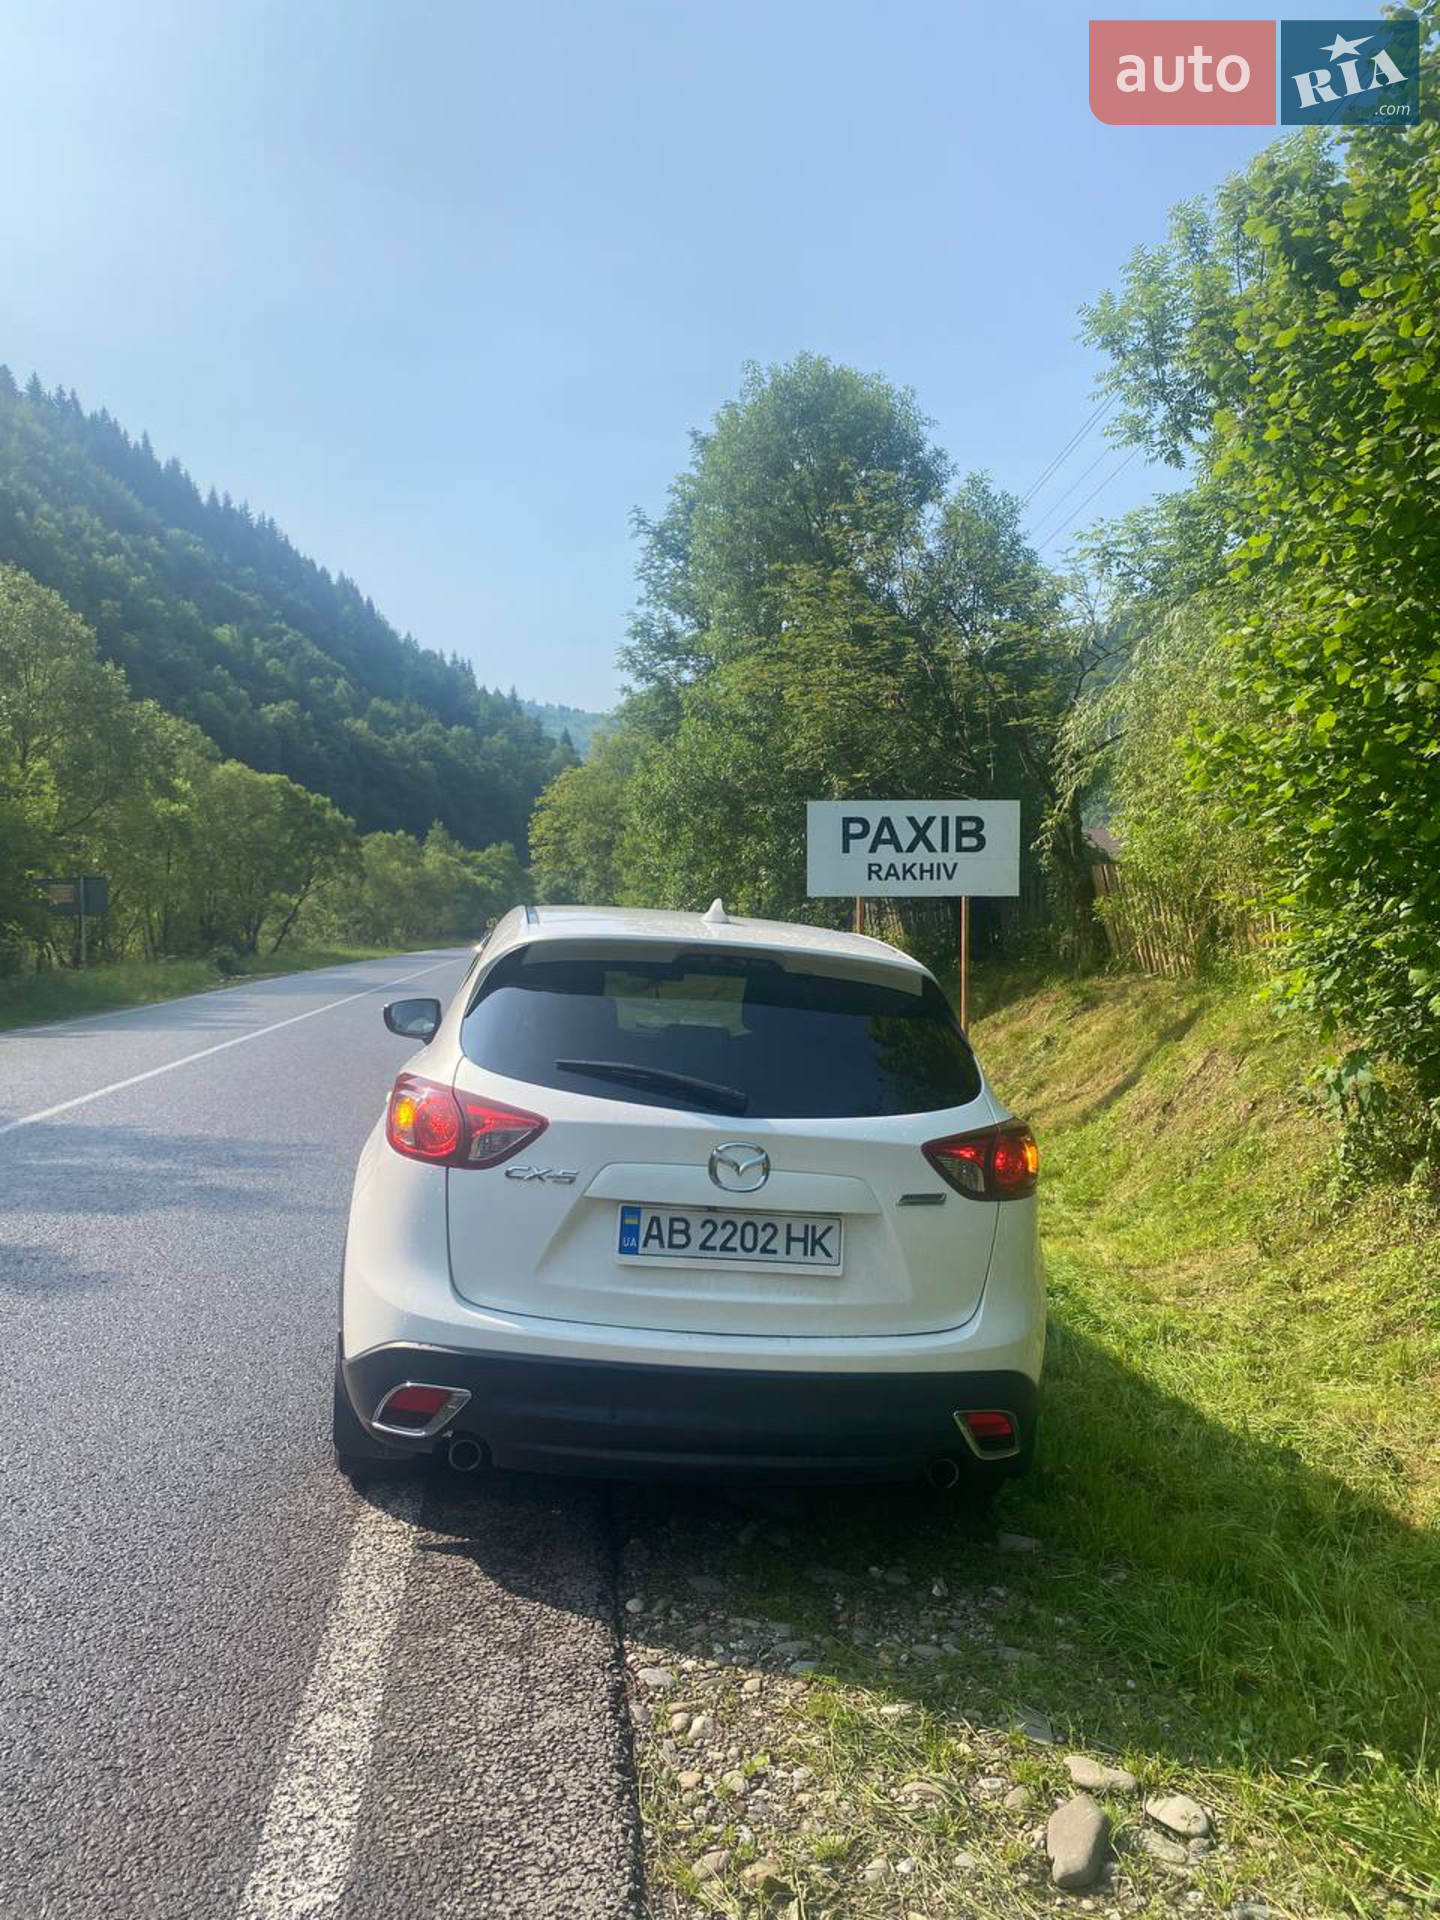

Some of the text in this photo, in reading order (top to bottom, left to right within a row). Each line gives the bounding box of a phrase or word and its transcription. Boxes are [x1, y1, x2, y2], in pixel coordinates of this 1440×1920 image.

[841, 815, 987, 854] РАХІВ
[867, 862, 959, 881] RAKHIV
[623, 1237, 637, 1248] UA
[642, 1216, 834, 1258] AB 2202 HK
